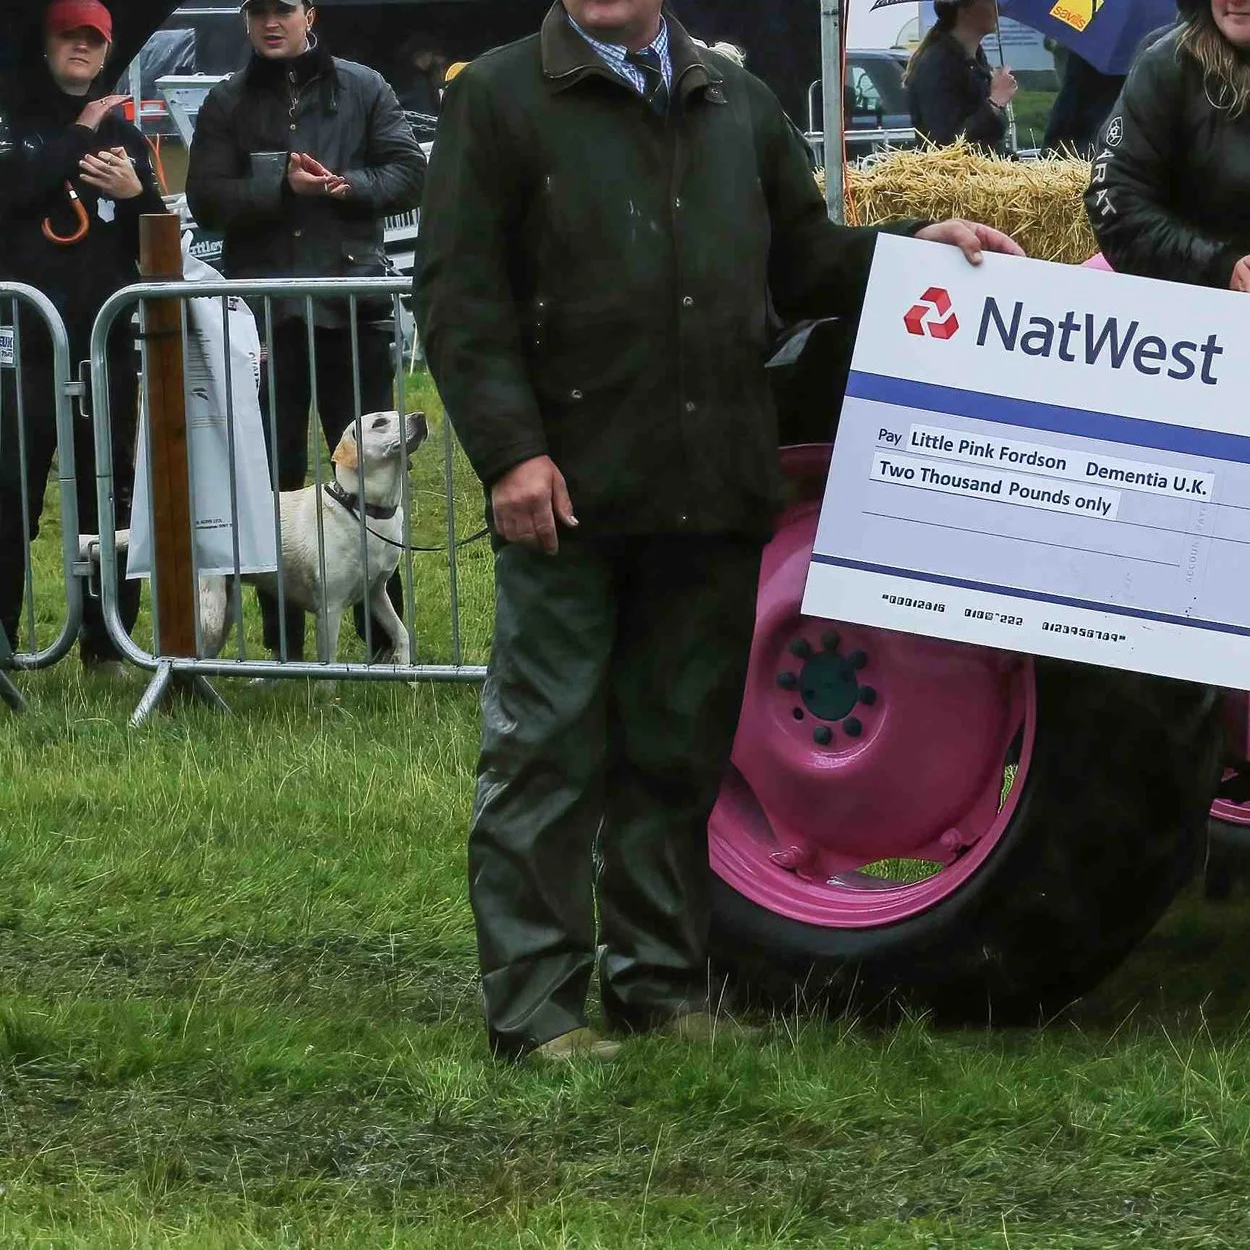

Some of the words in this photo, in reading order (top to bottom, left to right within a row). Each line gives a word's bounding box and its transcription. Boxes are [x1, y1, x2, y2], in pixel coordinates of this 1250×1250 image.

[1053, 6, 1086, 29] savills
[977, 297, 1223, 384] NatWest
[879, 429, 901, 445] Pay
[912, 432, 953, 451] Little
[959, 440, 994, 458] Pink
[1000, 447, 1066, 470] Fordson
[1086, 462, 1167, 488] Dementia
[1174, 477, 1206, 495] U.K.
[879, 461, 914, 483] Two
[920, 468, 1002, 496] Thousand
[1009, 482, 1069, 505] Pounds
[1075, 497, 1111, 515] only
